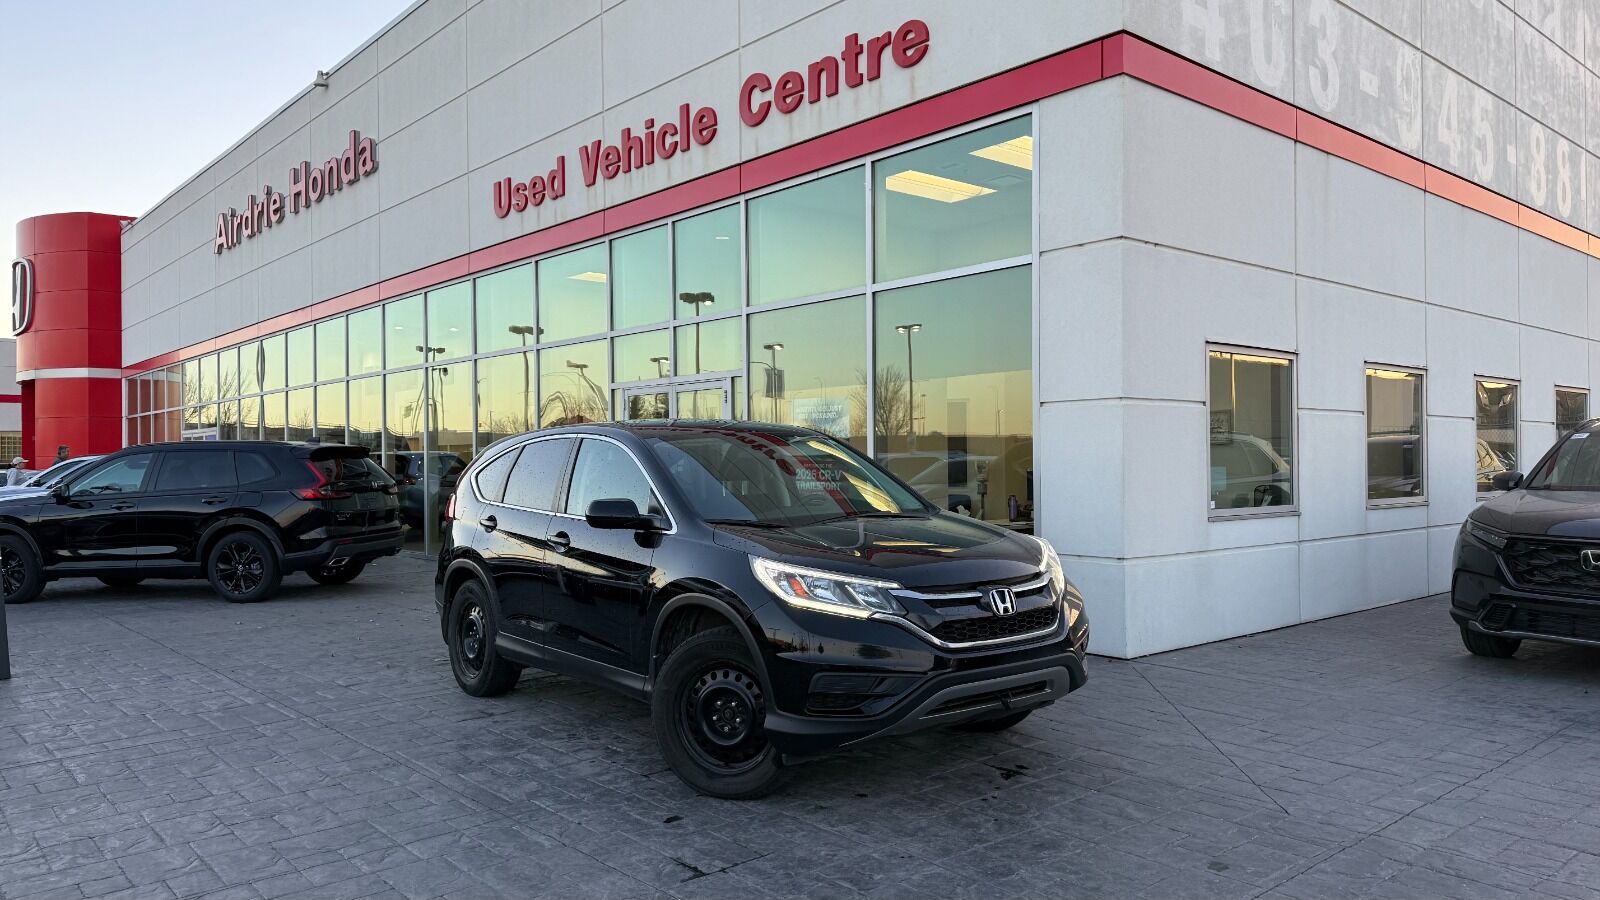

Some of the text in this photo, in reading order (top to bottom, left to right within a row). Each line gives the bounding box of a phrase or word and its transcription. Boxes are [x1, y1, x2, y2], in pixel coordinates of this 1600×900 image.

[492, 18, 931, 219] Used Vehicle Centre
[213, 129, 379, 254] Airdrie Honda
[795, 468, 842, 481] 2026 CR-V
